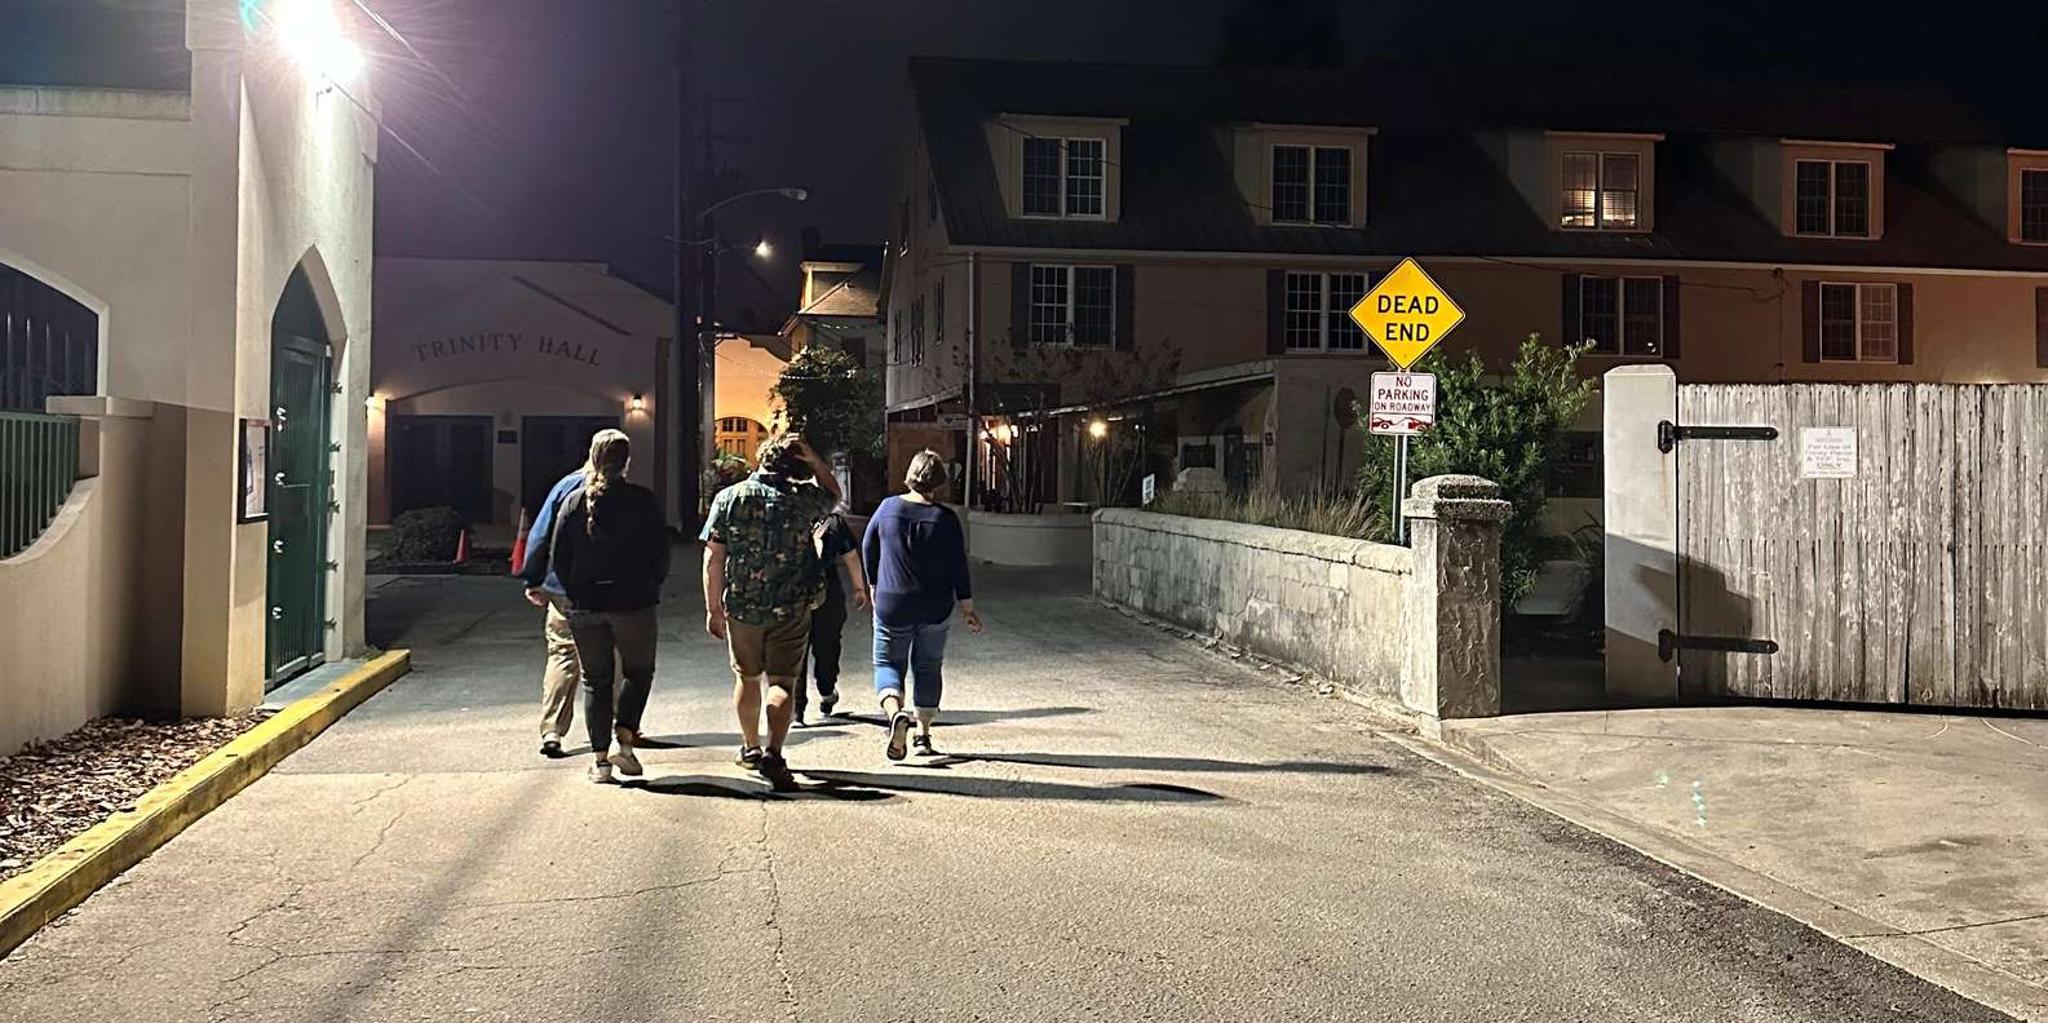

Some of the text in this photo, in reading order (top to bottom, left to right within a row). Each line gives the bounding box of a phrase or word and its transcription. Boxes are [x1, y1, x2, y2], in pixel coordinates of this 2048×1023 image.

[1377, 294, 1439, 314] DEAD
[1385, 322, 1430, 342] END
[412, 333, 601, 367] TRINITY HALL
[1395, 376, 1412, 387] NO
[1378, 388, 1429, 401] PARKING
[1374, 401, 1431, 412] ON ROADWAY
